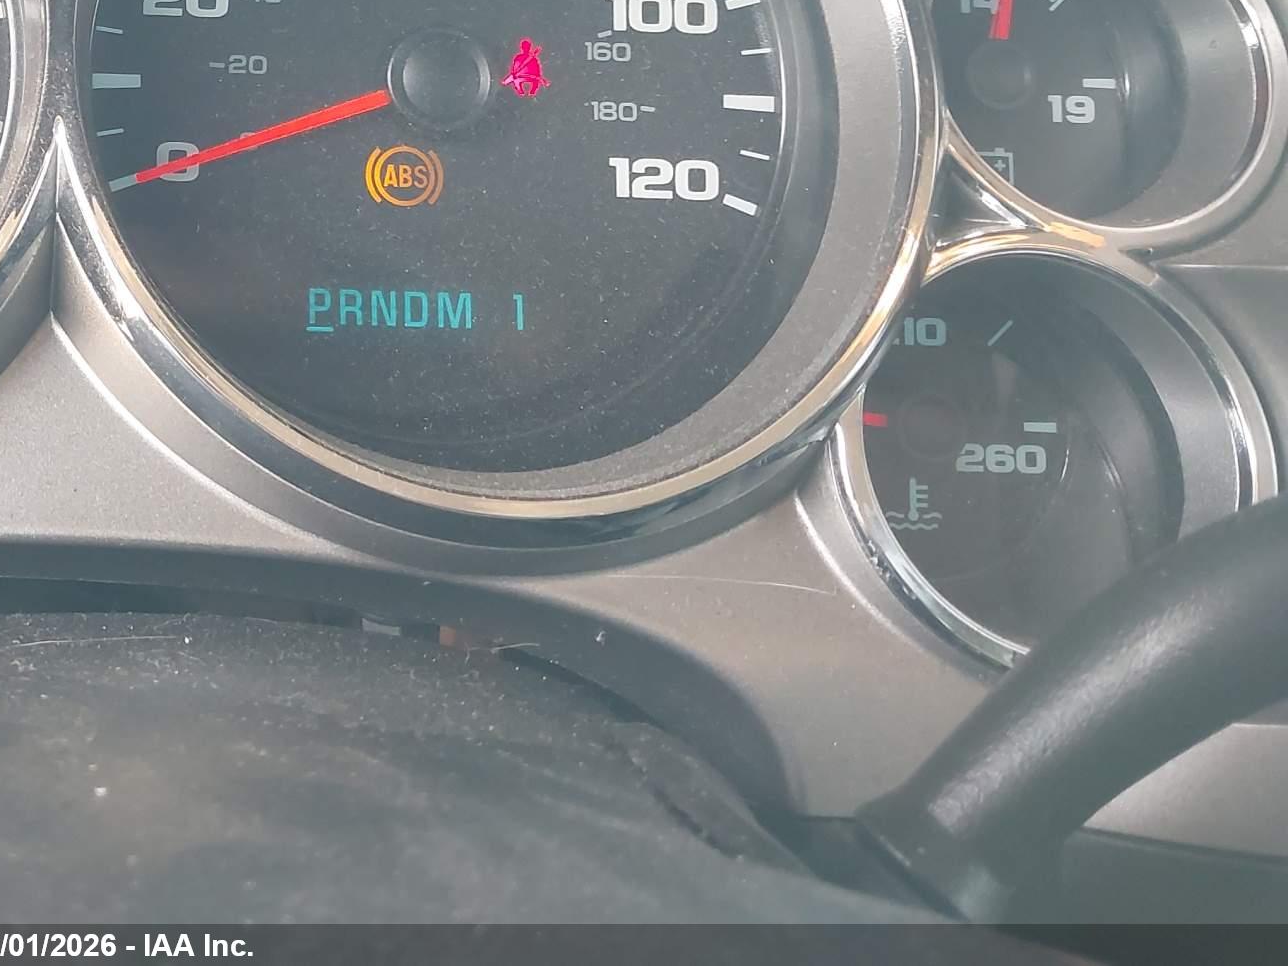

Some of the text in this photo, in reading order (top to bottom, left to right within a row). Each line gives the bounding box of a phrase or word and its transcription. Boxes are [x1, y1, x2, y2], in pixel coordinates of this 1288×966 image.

[228, 54, 268, 75] 20
[584, 42, 632, 62] 160
[591, 100, 638, 122] 180
[1047, 94, 1096, 124] 19
[156, 141, 200, 182] 0
[383, 164, 428, 189] ABS
[609, 158, 720, 201] 120
[955, 443, 1047, 474] 260
